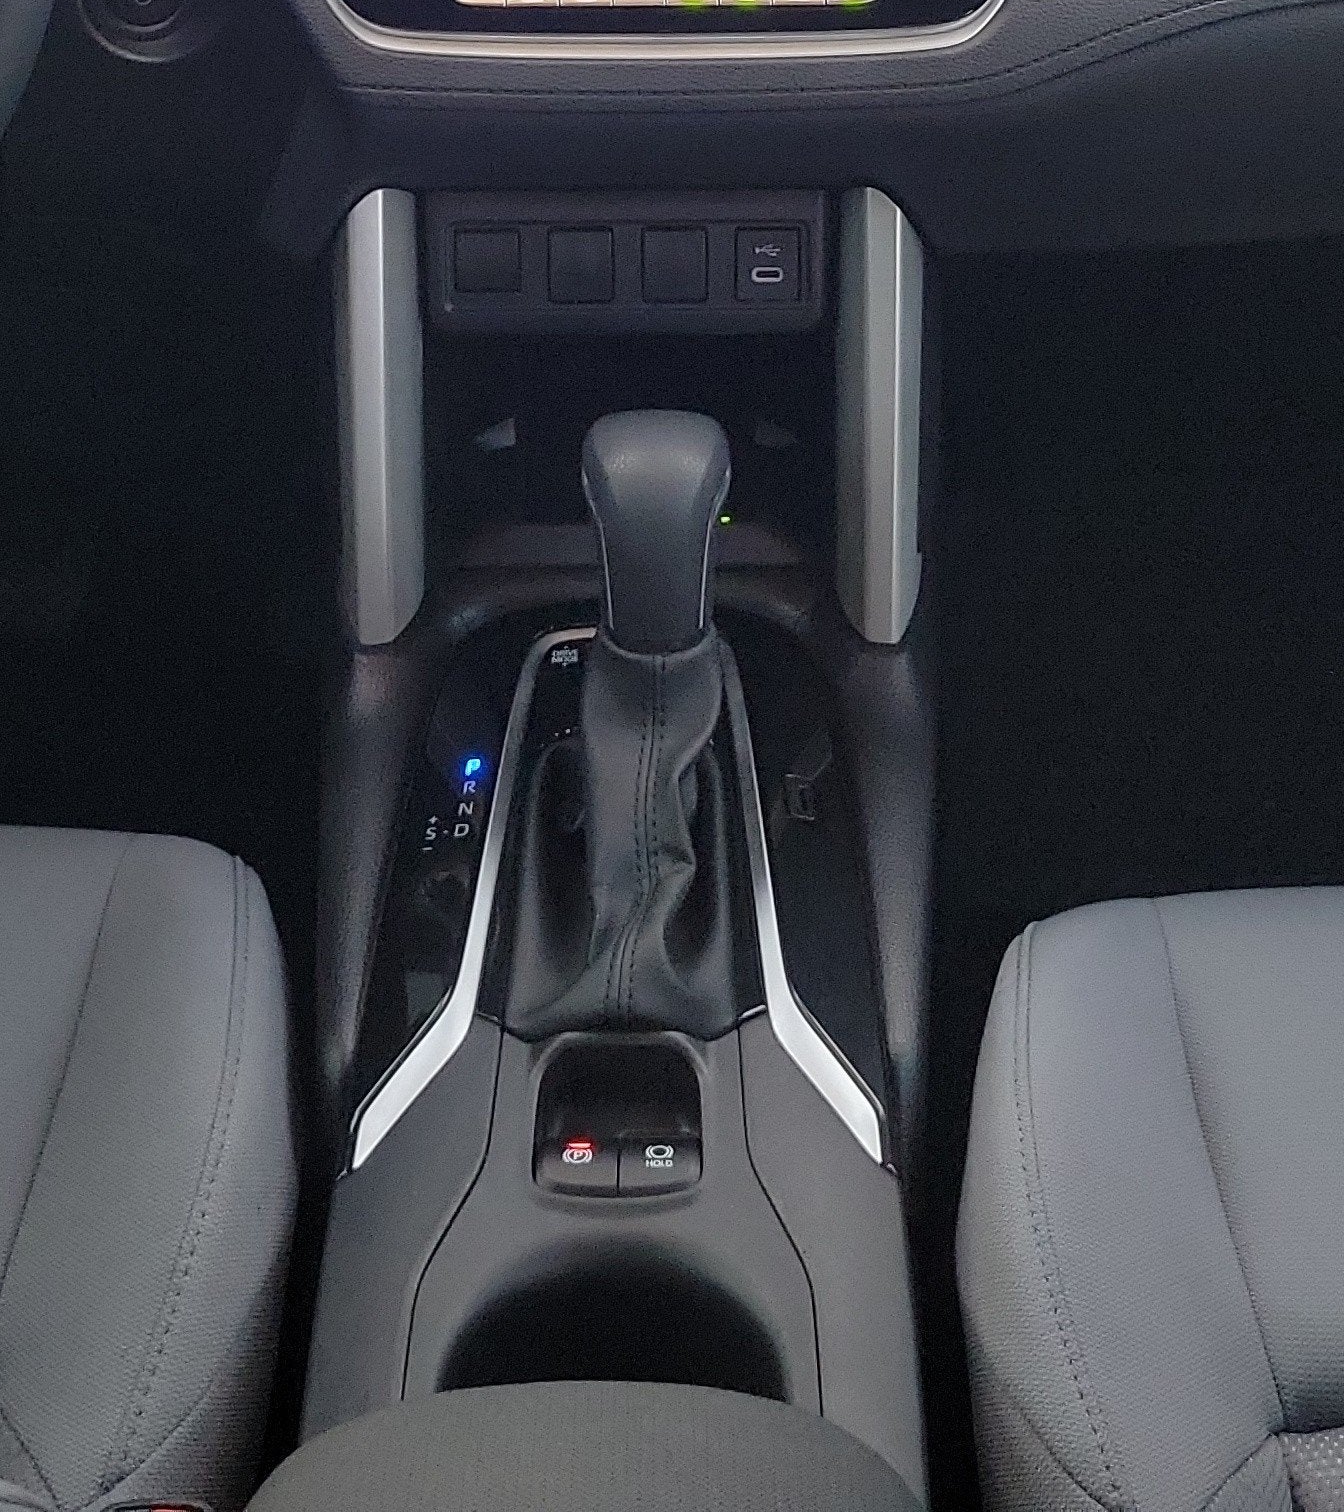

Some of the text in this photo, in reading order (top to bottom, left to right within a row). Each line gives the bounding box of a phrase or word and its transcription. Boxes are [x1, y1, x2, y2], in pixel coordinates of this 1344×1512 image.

[465, 758, 481, 777] P
[463, 780, 476, 795] R
[458, 800, 474, 816] N
[424, 823, 469, 841] S D
[645, 1159, 674, 1168] HOLD
